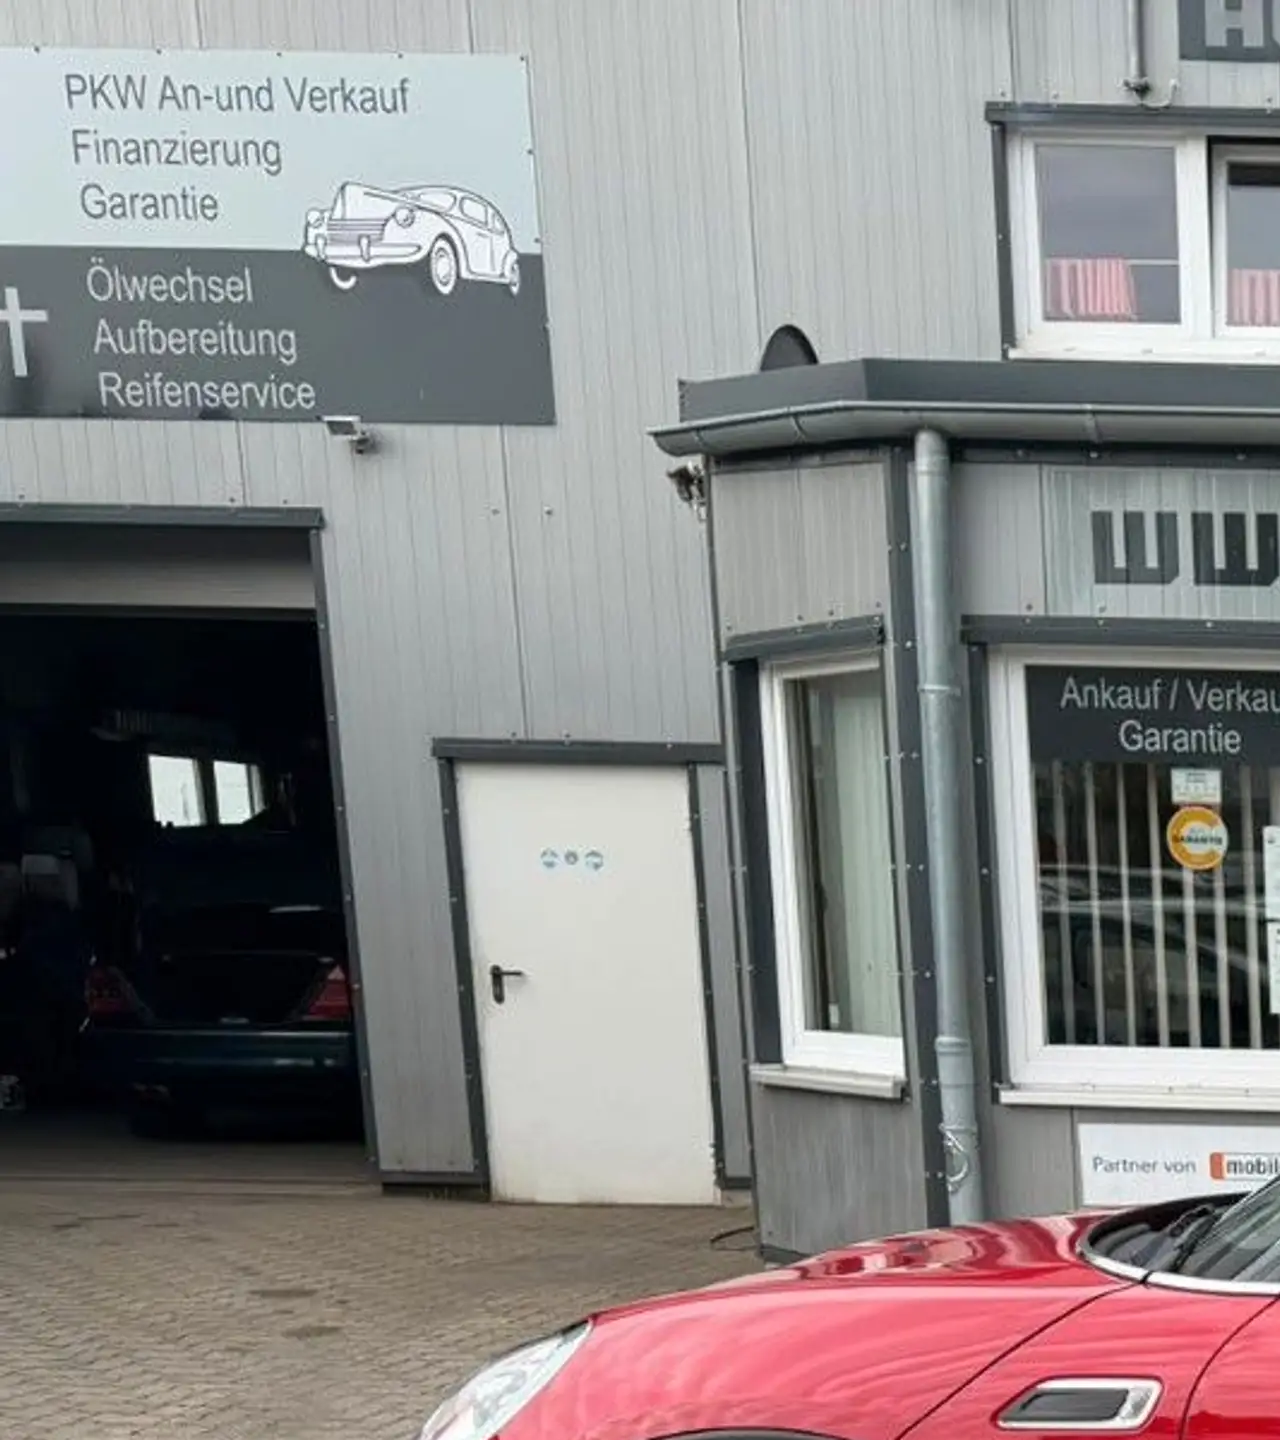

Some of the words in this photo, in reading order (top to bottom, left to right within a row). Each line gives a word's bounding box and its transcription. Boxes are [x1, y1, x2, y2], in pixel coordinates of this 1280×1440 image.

[64, 73, 147, 111] PKW
[158, 75, 274, 113] An-und
[283, 77, 410, 114] Verkauf
[71, 128, 282, 176] Finanzierung
[79, 182, 220, 222] Garantie
[86, 256, 253, 303] Ölwechsel
[93, 317, 298, 366] Aufbereitung
[98, 371, 316, 410] Reifenservice
[1060, 675, 1162, 710] Ankauf
[1118, 719, 1242, 754] Garantie
[1092, 1155, 1159, 1174] Partner
[1163, 1157, 1198, 1174] von
